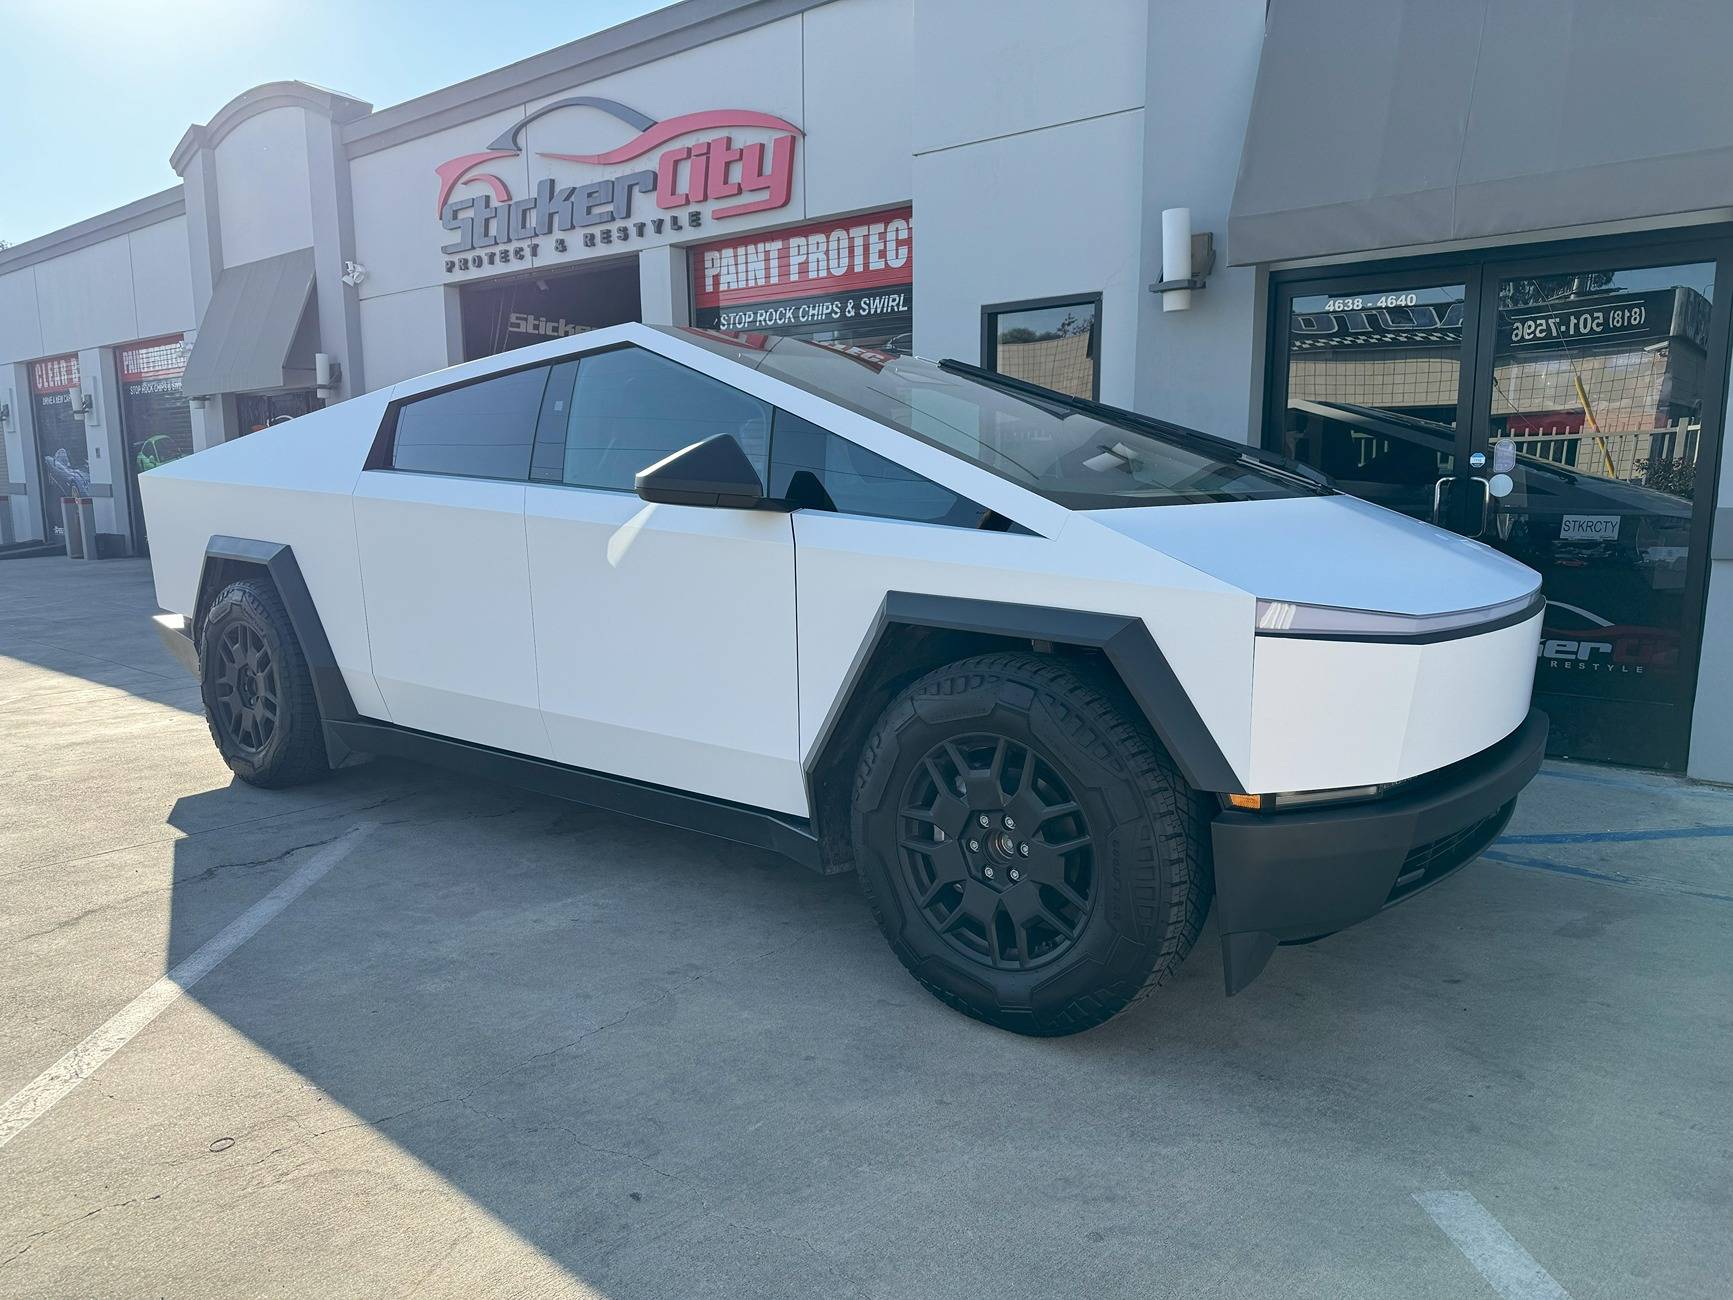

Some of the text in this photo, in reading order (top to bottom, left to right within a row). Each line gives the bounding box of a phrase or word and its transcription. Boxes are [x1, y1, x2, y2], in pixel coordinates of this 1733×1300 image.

[444, 210, 702, 273] PROTECT & RESTYLE
[704, 240, 783, 293] PAINT
[720, 293, 909, 331] STOP ROCK CHIPS & SWIRL
[1325, 297, 1362, 311] 4638
[1376, 293, 1417, 308] 4640
[508, 312, 597, 336] Sticke
[35, 360, 68, 389] CLEAR
[1563, 519, 1618, 533] STKRCTY
[1550, 661, 1644, 674] RESTYLE
